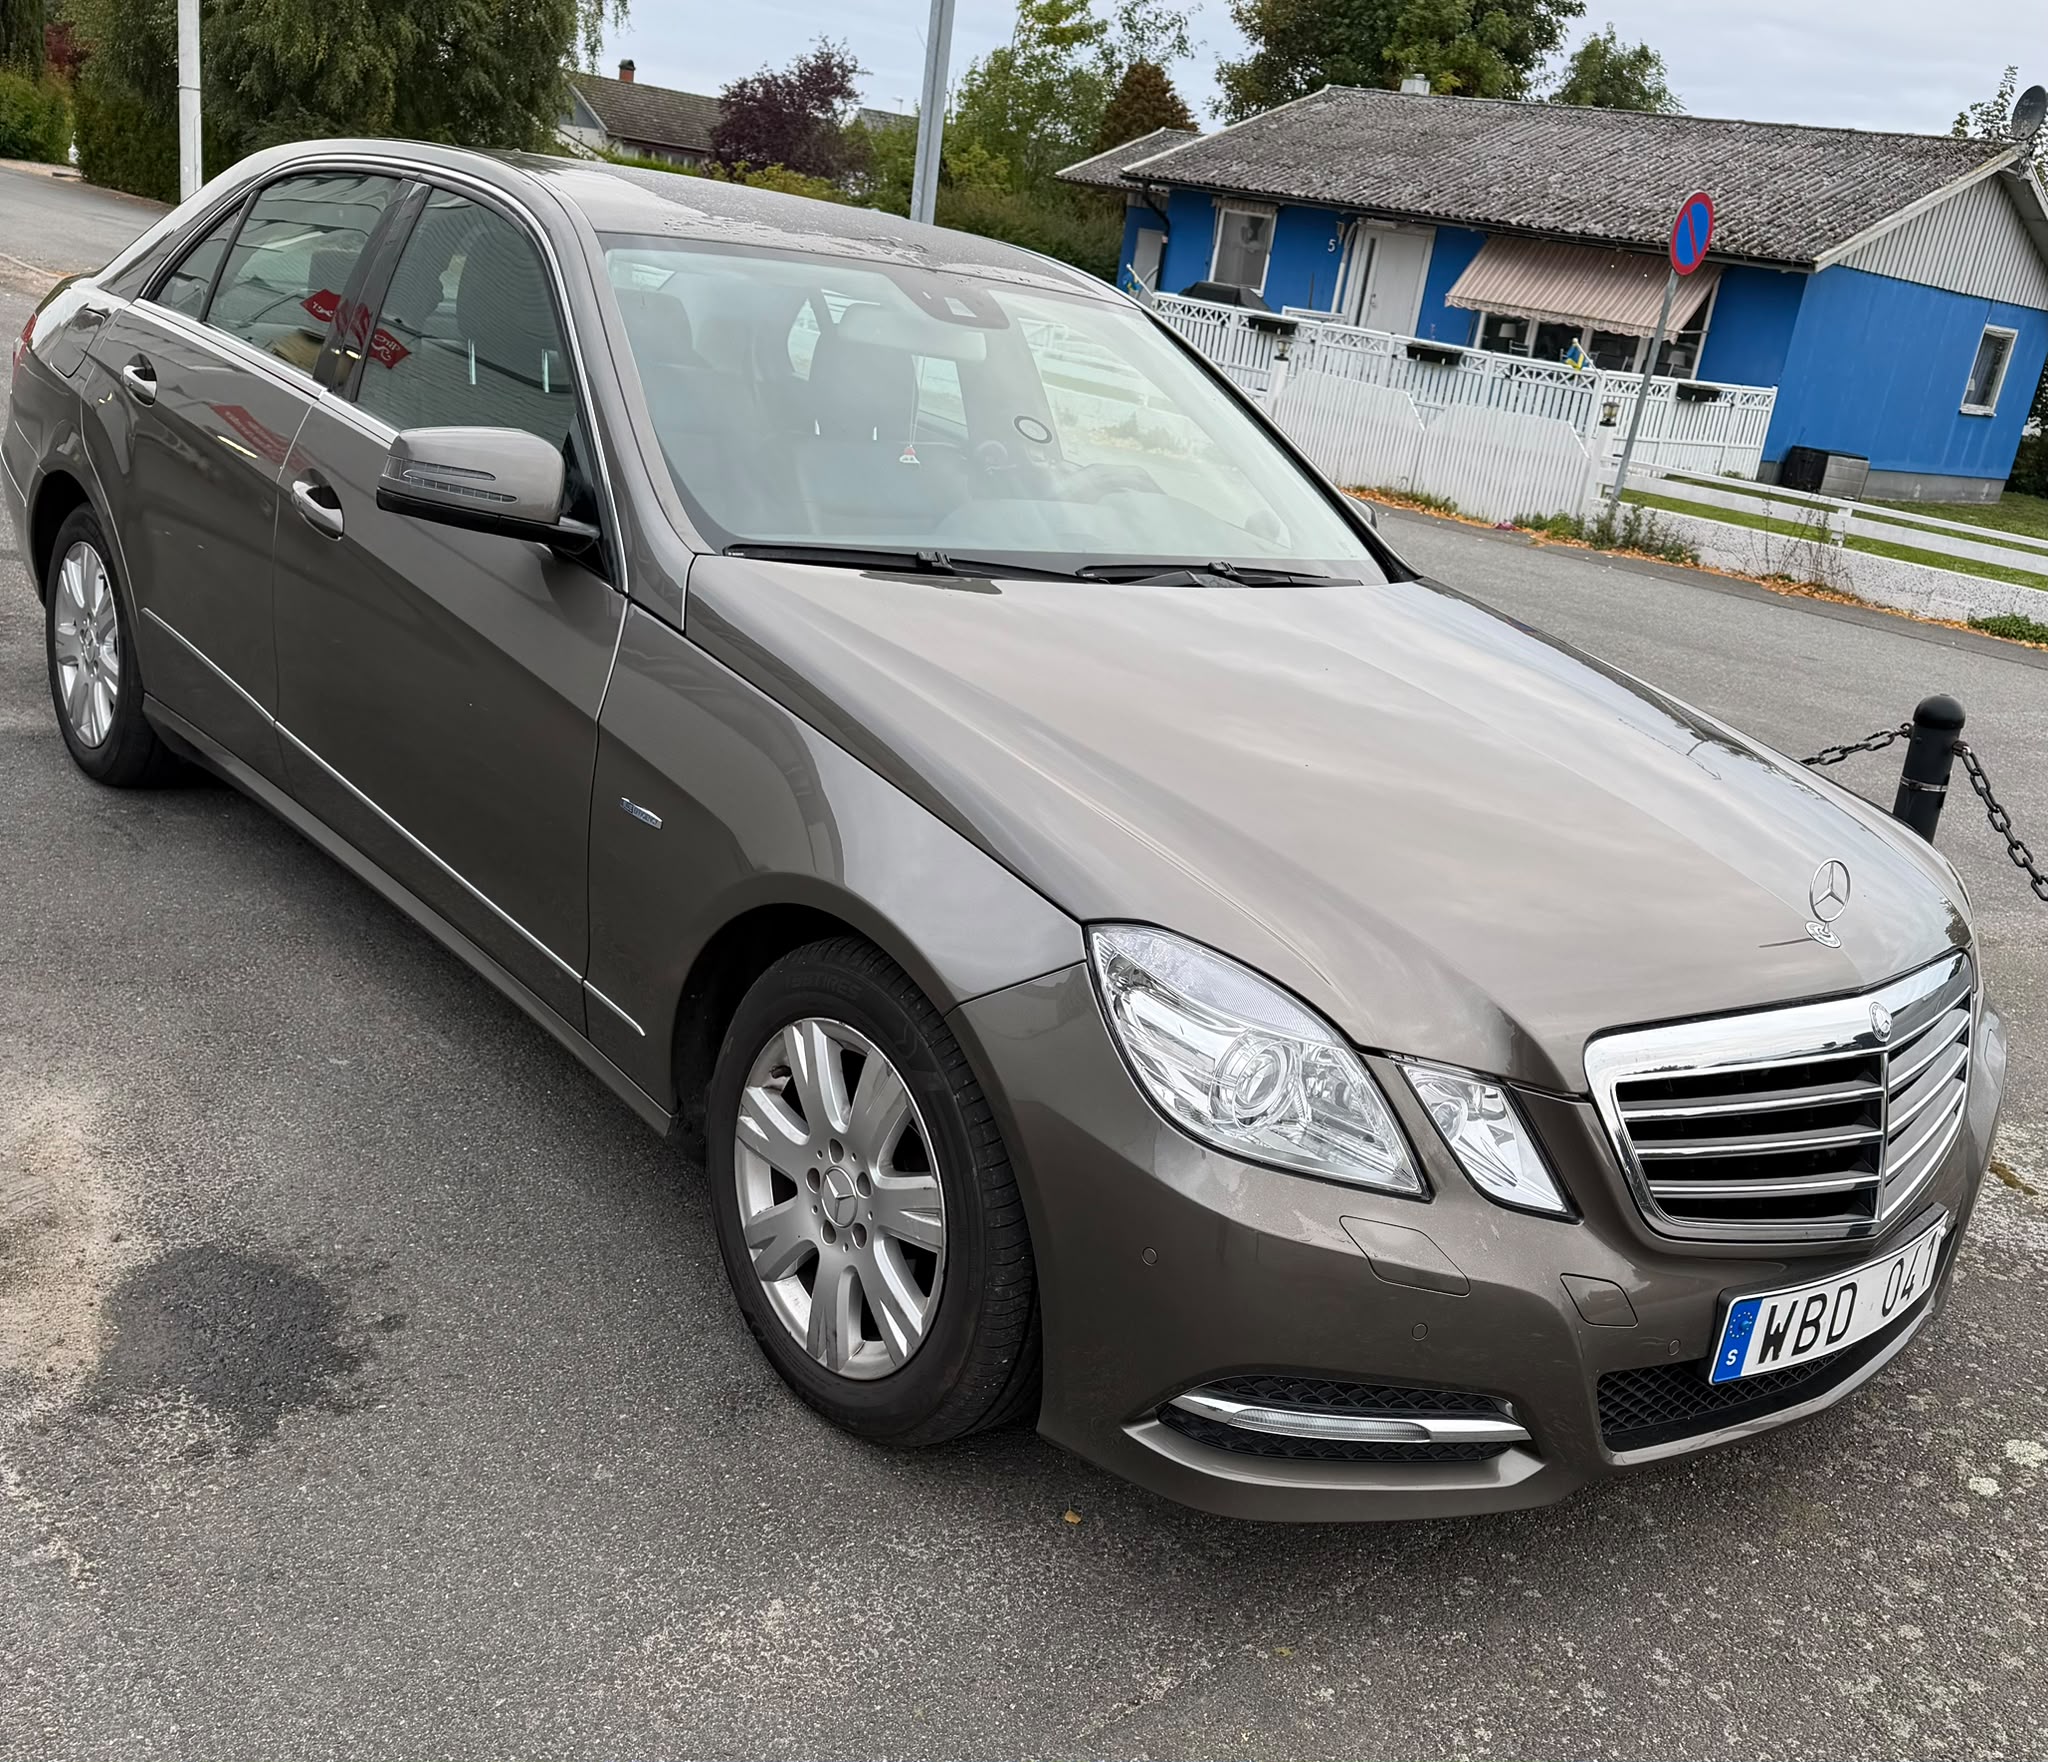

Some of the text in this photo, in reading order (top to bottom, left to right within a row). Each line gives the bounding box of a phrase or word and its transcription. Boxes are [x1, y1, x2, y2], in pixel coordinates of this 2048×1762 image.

[1327, 238, 1337, 253] 5
[1757, 1230, 1938, 1365] WBD 041
[1725, 1348, 1738, 1366] S
